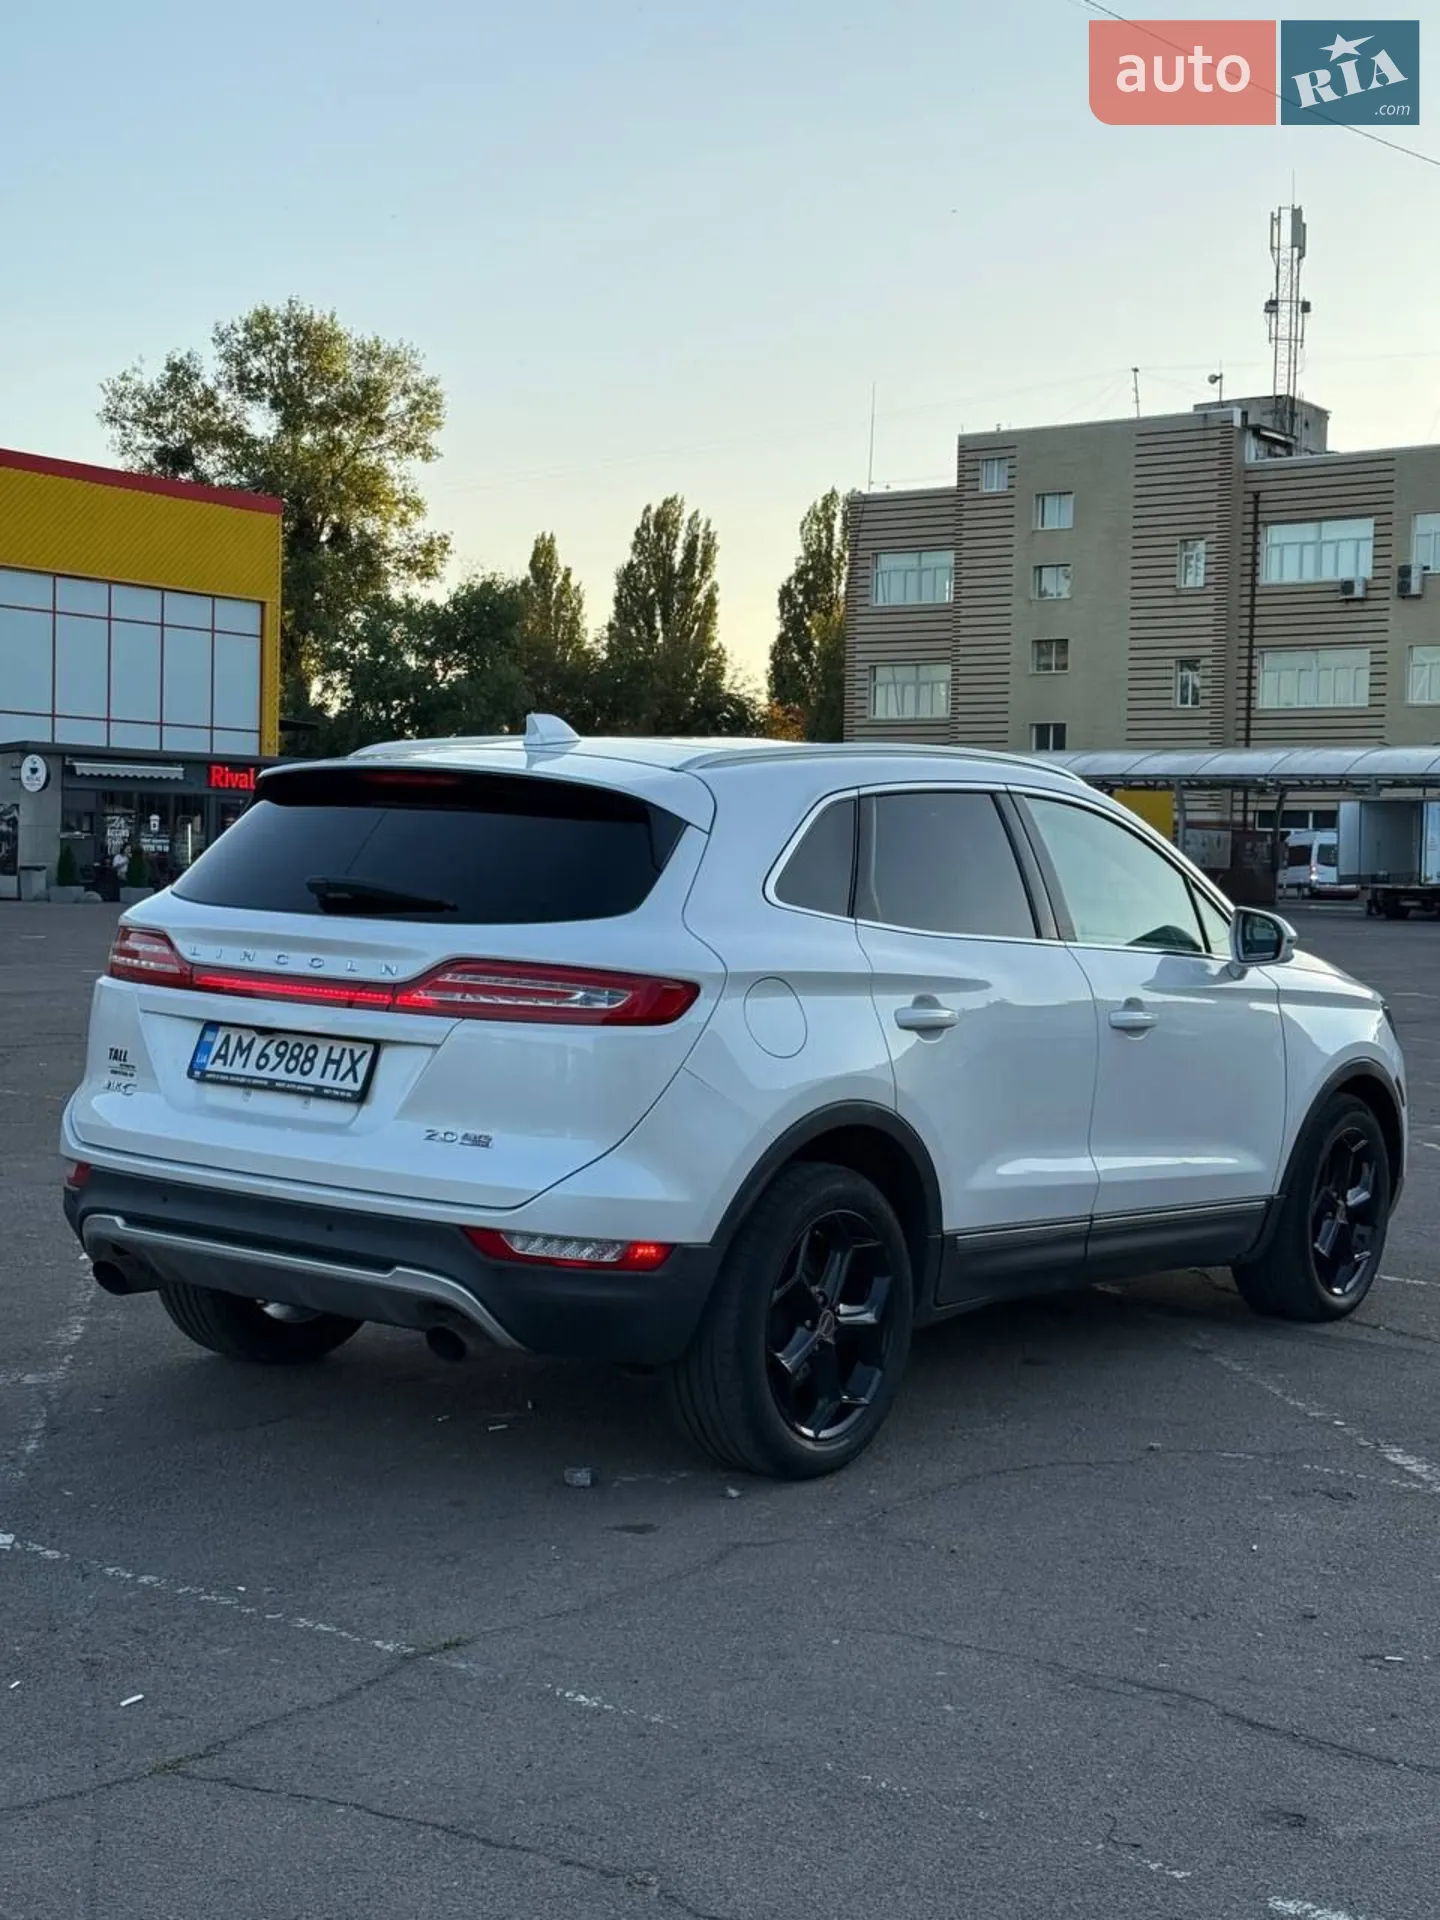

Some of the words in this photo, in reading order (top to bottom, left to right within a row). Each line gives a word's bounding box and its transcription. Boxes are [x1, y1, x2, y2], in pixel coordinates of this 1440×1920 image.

[210, 765, 256, 791] Rival
[189, 946, 398, 976] LINCOLN
[108, 1047, 129, 1063] TALL
[210, 1033, 256, 1069] AM
[255, 1038, 319, 1077] 6988
[320, 1045, 368, 1084] HX
